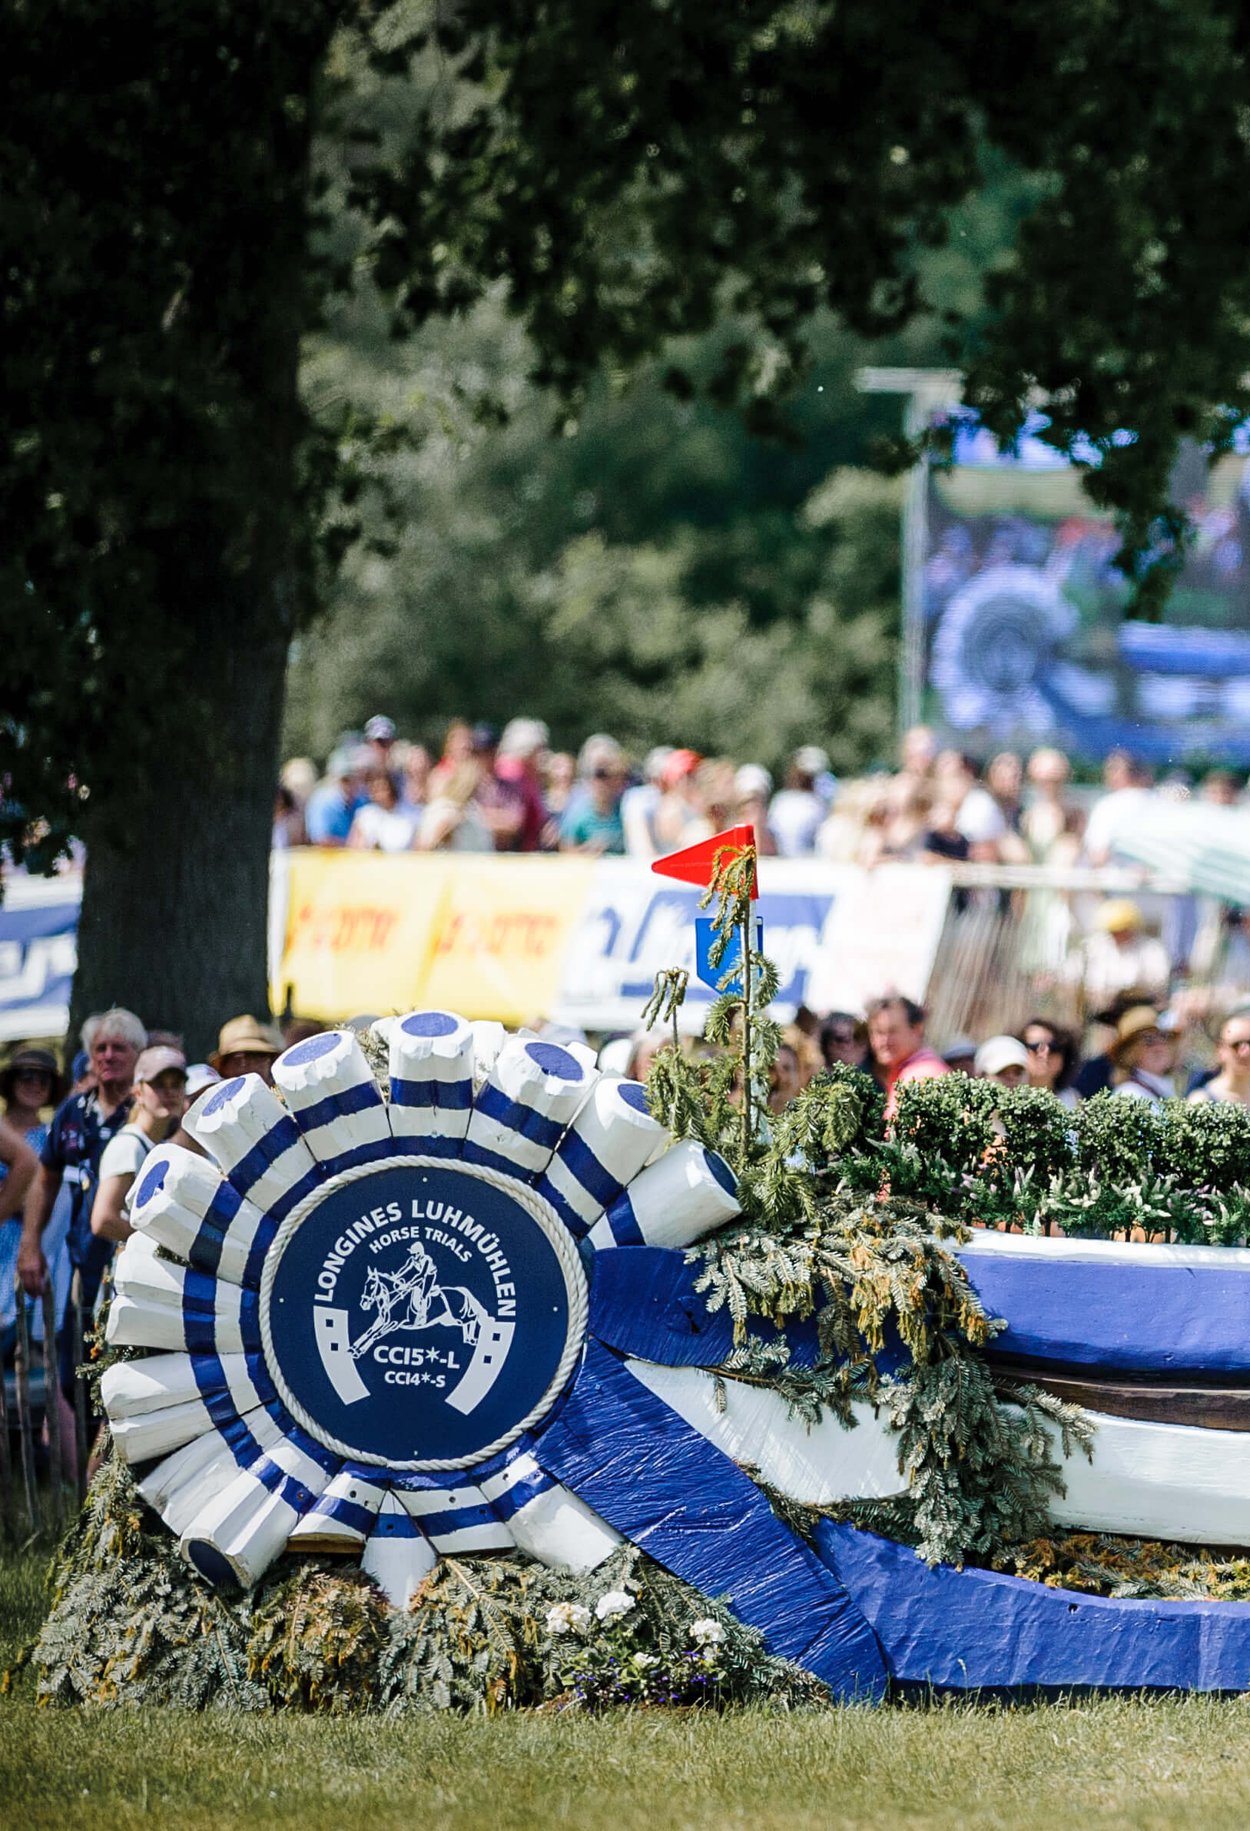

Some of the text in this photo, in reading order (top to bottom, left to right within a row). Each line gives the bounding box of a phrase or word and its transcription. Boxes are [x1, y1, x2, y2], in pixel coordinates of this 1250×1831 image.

[314, 1200, 516, 1316] LONGINES LUHMÜHLEN
[369, 1226, 472, 1262] HORSE TRIALS
